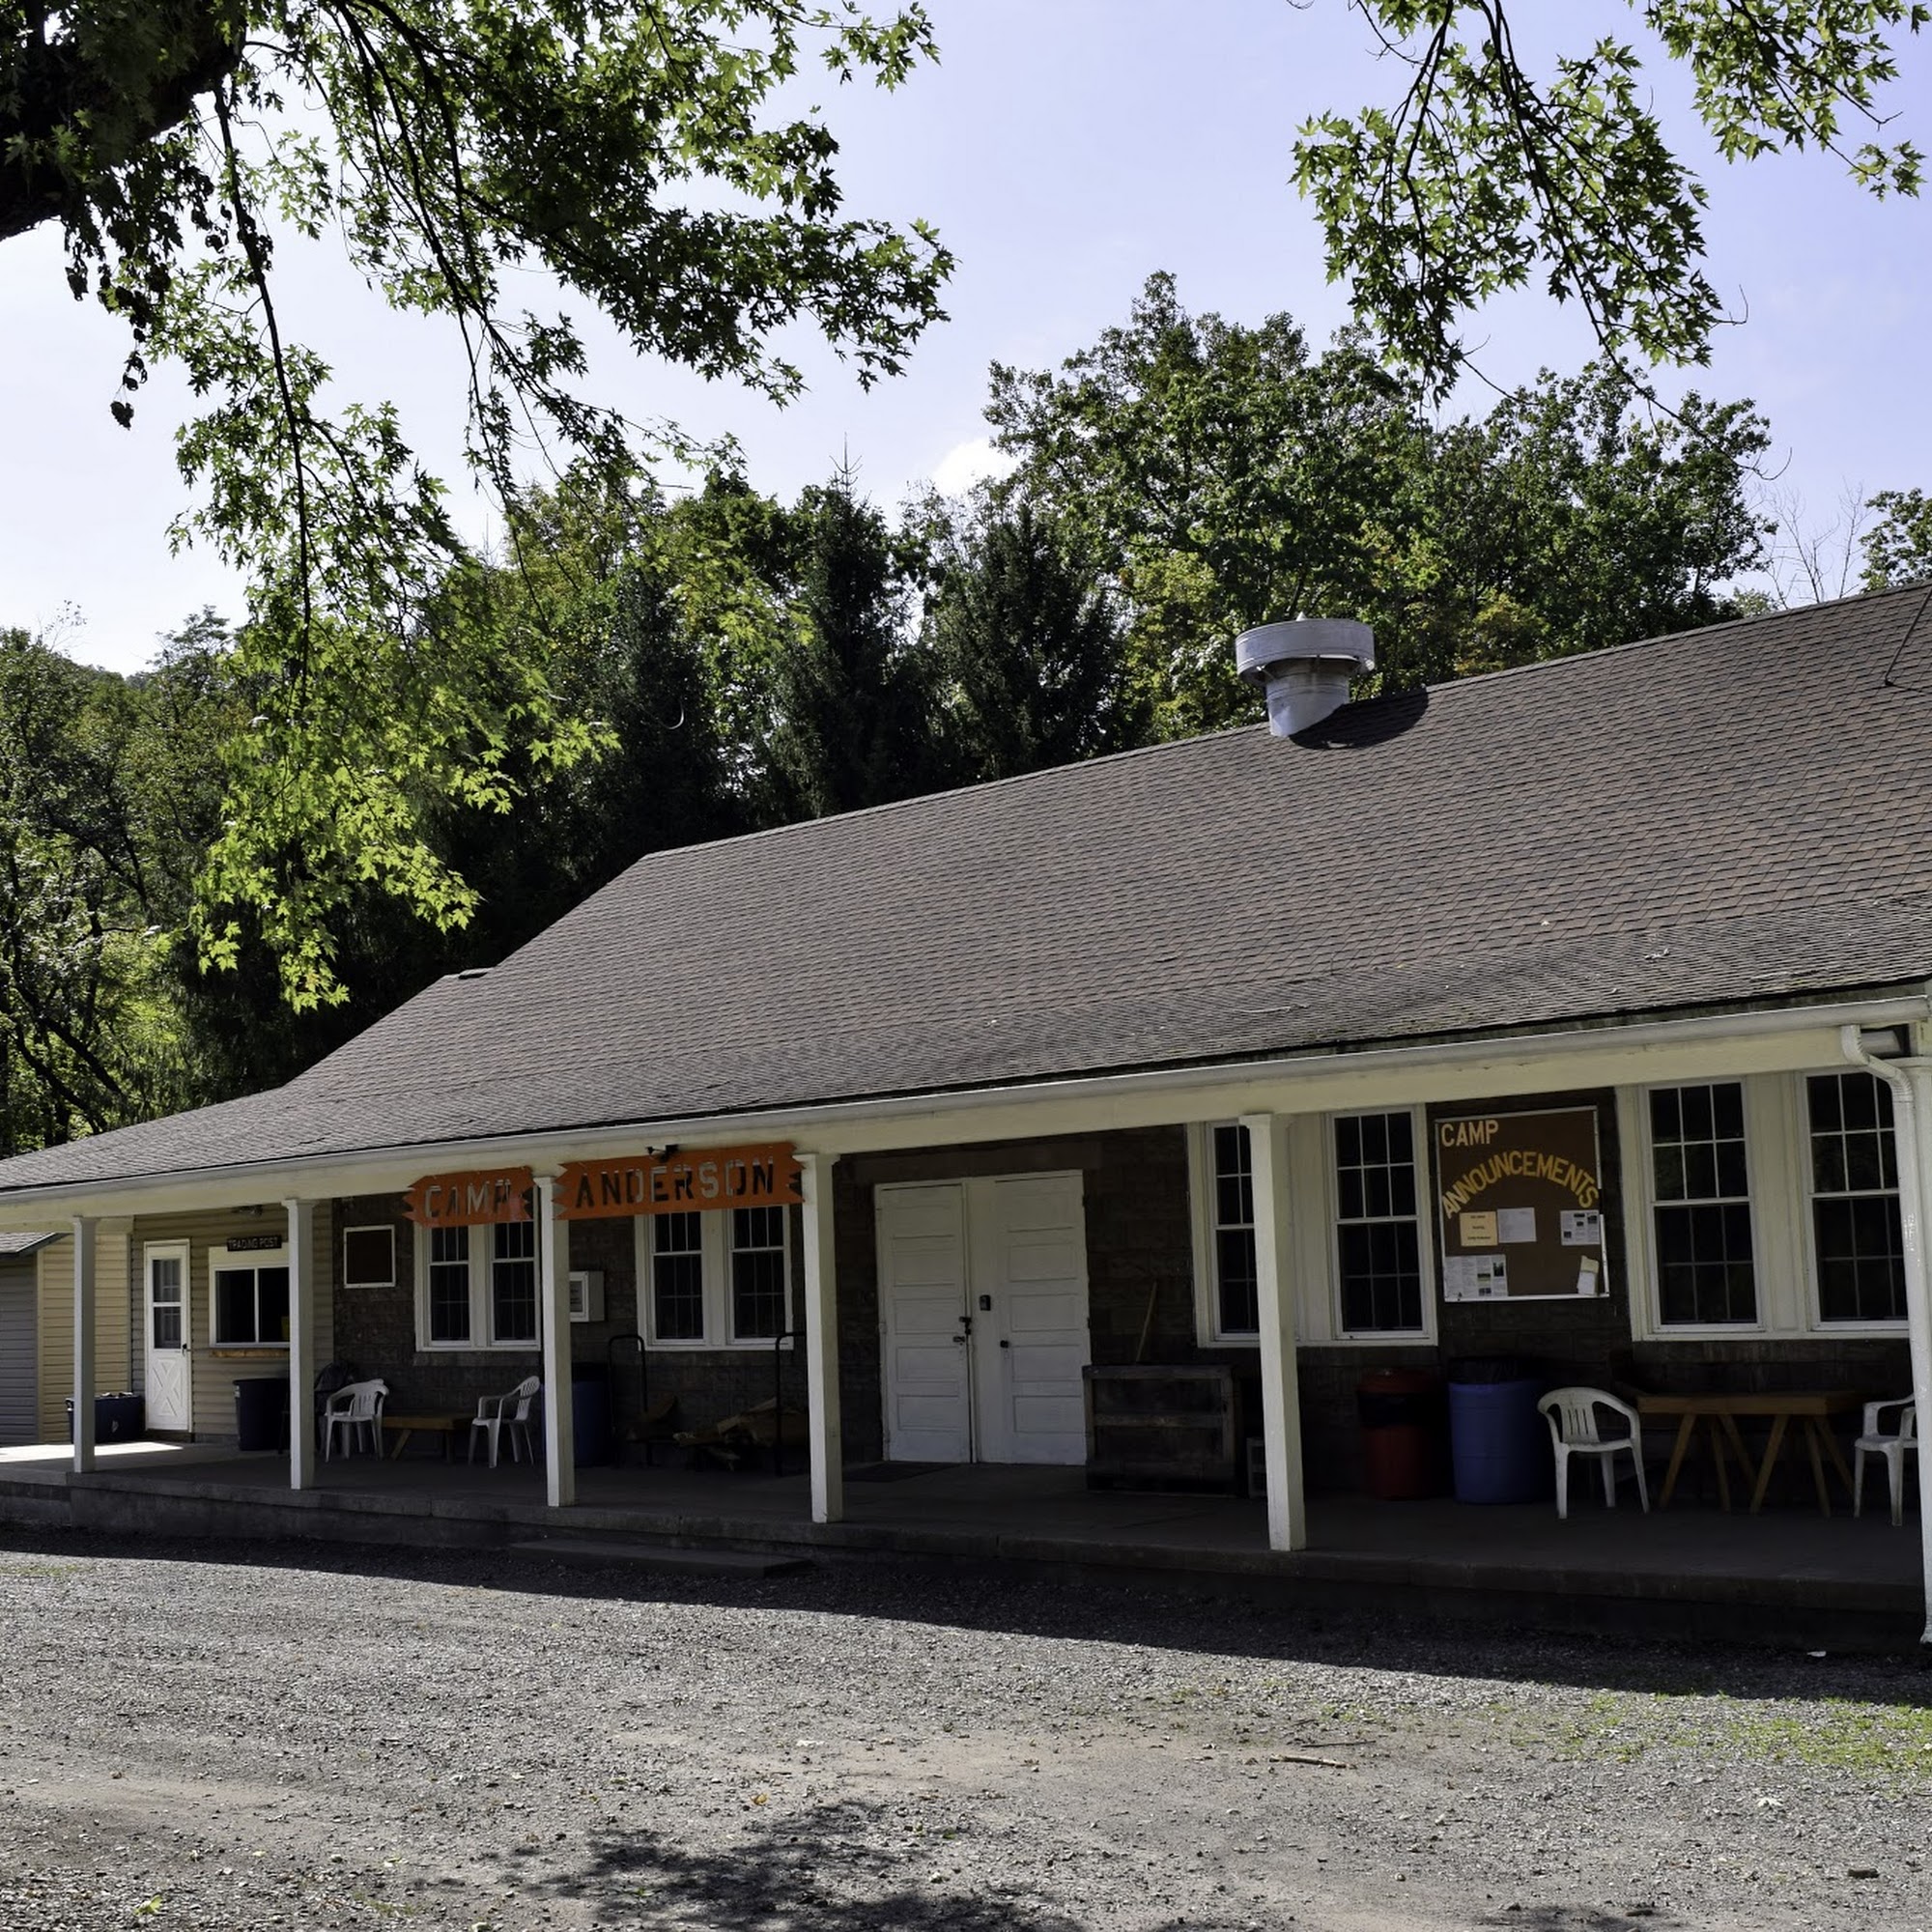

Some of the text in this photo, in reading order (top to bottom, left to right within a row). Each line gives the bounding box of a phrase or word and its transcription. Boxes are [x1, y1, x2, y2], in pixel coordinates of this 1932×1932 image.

[1440, 1120, 1499, 1148] CAMP
[424, 1158, 775, 1219] CAMP ANDERSON
[1442, 1151, 1599, 1219] ANNOUNCEMENTS
[229, 1237, 278, 1249] TRADING POST
